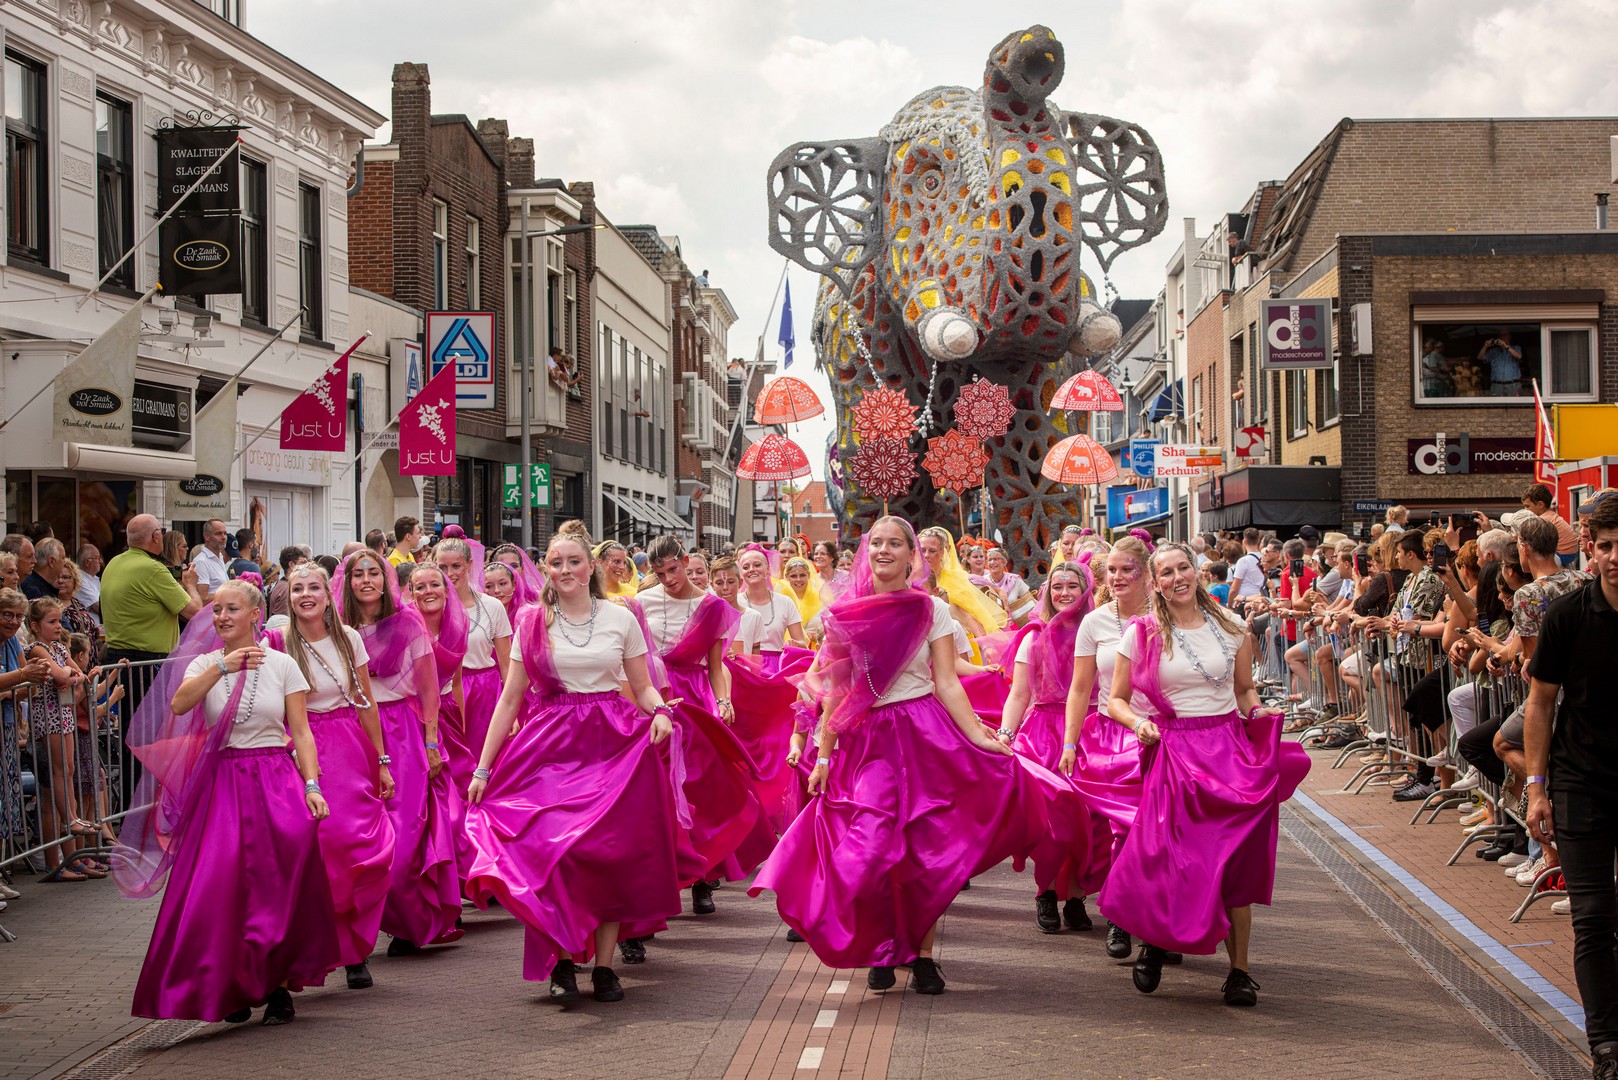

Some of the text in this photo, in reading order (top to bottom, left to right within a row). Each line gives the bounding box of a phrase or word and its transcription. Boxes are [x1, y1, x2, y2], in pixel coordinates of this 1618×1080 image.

[186, 246, 218, 256] De Zaak
[183, 252, 222, 262] vol Smaak
[1290, 309, 1301, 347] dubbel
[1272, 350, 1324, 359] modeschoenen
[79, 392, 112, 403] De Zaak
[76, 399, 115, 410] vol Smaak
[145, 399, 176, 418] GRAUMANS
[285, 420, 342, 442] just U
[372, 433, 397, 441] Sorthal
[1162, 447, 1186, 457] Sha
[1437, 437, 1447, 473] dubbel
[403, 449, 453, 470] just U
[1157, 467, 1200, 475] Eethuis
[199, 478, 216, 486] Zaak
